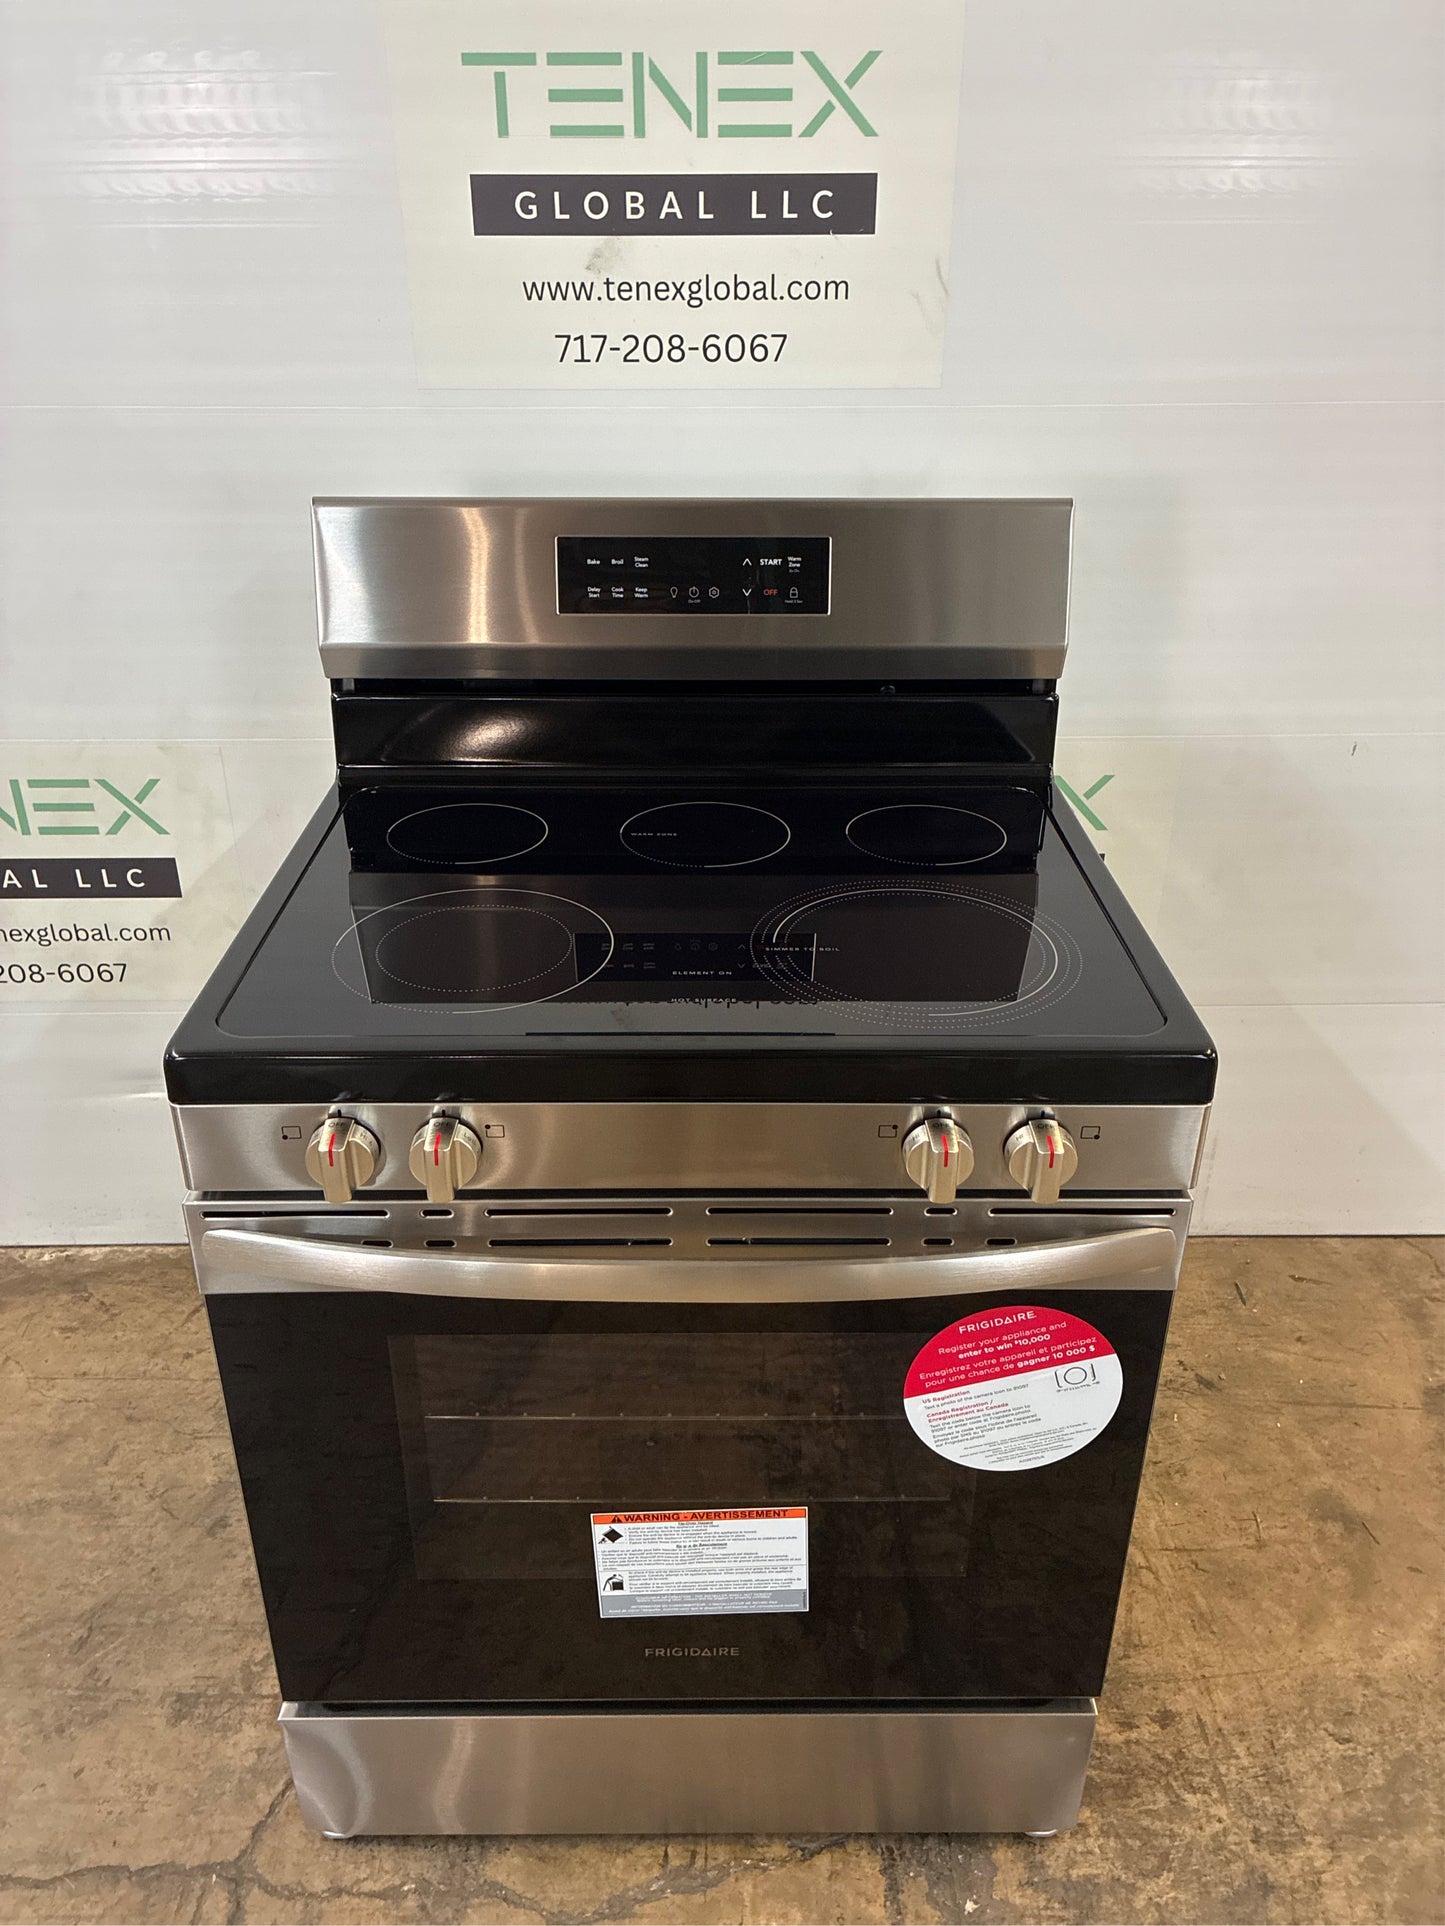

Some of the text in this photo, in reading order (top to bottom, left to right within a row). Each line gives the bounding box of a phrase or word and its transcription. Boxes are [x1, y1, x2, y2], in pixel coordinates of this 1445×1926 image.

[461, 50, 883, 138] TENEX
[514, 190, 834, 220] GLOBAL LLC
[522, 274, 850, 308] www.tenexglobal.com
[554, 334, 788, 363] 717-208-6067
[760, 558, 782, 566] START
[763, 588, 779, 596] OFF
[75, 868, 146, 888] LLC
[958, 1310, 1036, 1334] FRIGIDAIRE
[938, 1321, 1066, 1355] Register your appliance and
[957, 1348, 982, 1359] enter
[996, 1341, 1012, 1350] win
[1014, 1332, 1050, 1347] $10,000
[919, 1362, 970, 1380] Enregistrez
[972, 1357, 996, 1368] votre
[998, 1348, 1036, 1363] appareil
[1050, 1335, 1096, 1352] participez
[925, 1344, 1095, 1387] pour une chance de gagner 10 000 $
[932, 1389, 970, 1402] Registration
[926, 1409, 949, 1418] Canada
[951, 1400, 988, 1413] Registration
[928, 1409, 974, 1423] Enregistrement
[985, 1402, 1008, 1410] Canada
[624, 1512, 680, 1522] WARNING
[690, 1509, 788, 1520] AVERTISSEMENT
[644, 1648, 740, 1657] FRIGIDAIRE
